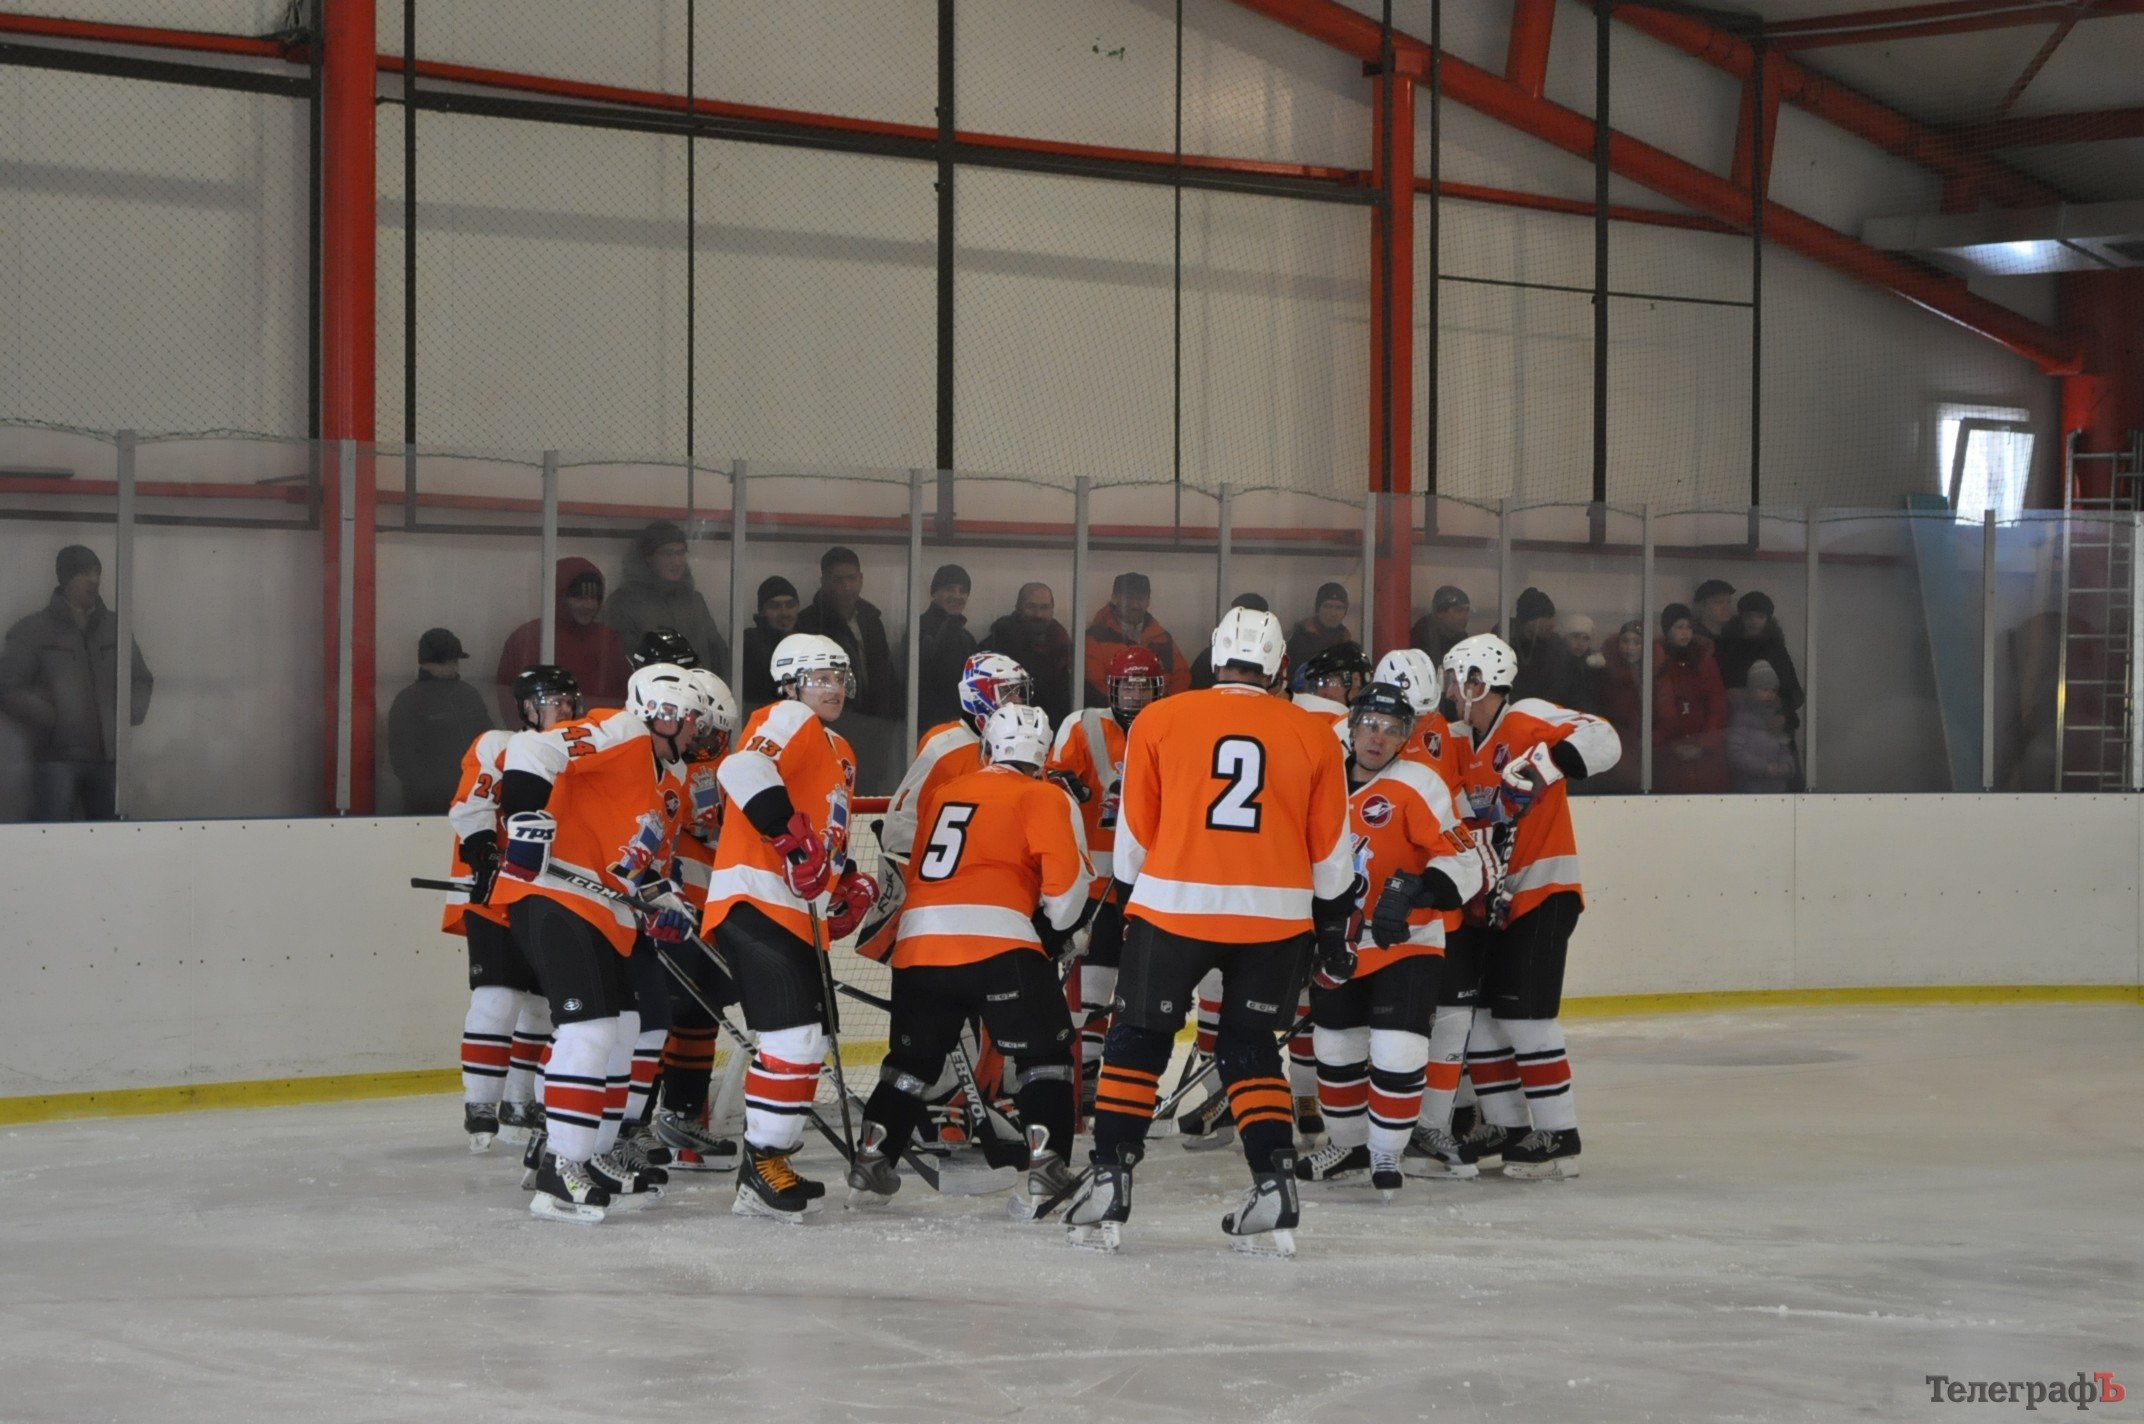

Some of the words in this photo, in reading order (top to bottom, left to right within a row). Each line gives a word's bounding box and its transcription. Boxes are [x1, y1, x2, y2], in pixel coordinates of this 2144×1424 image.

[561, 726, 596, 757] 44
[746, 735, 783, 757] 13
[1205, 734, 1266, 834] 2
[515, 826, 555, 840] TPS
[918, 801, 979, 882] 5
[572, 876, 619, 898] CCM
